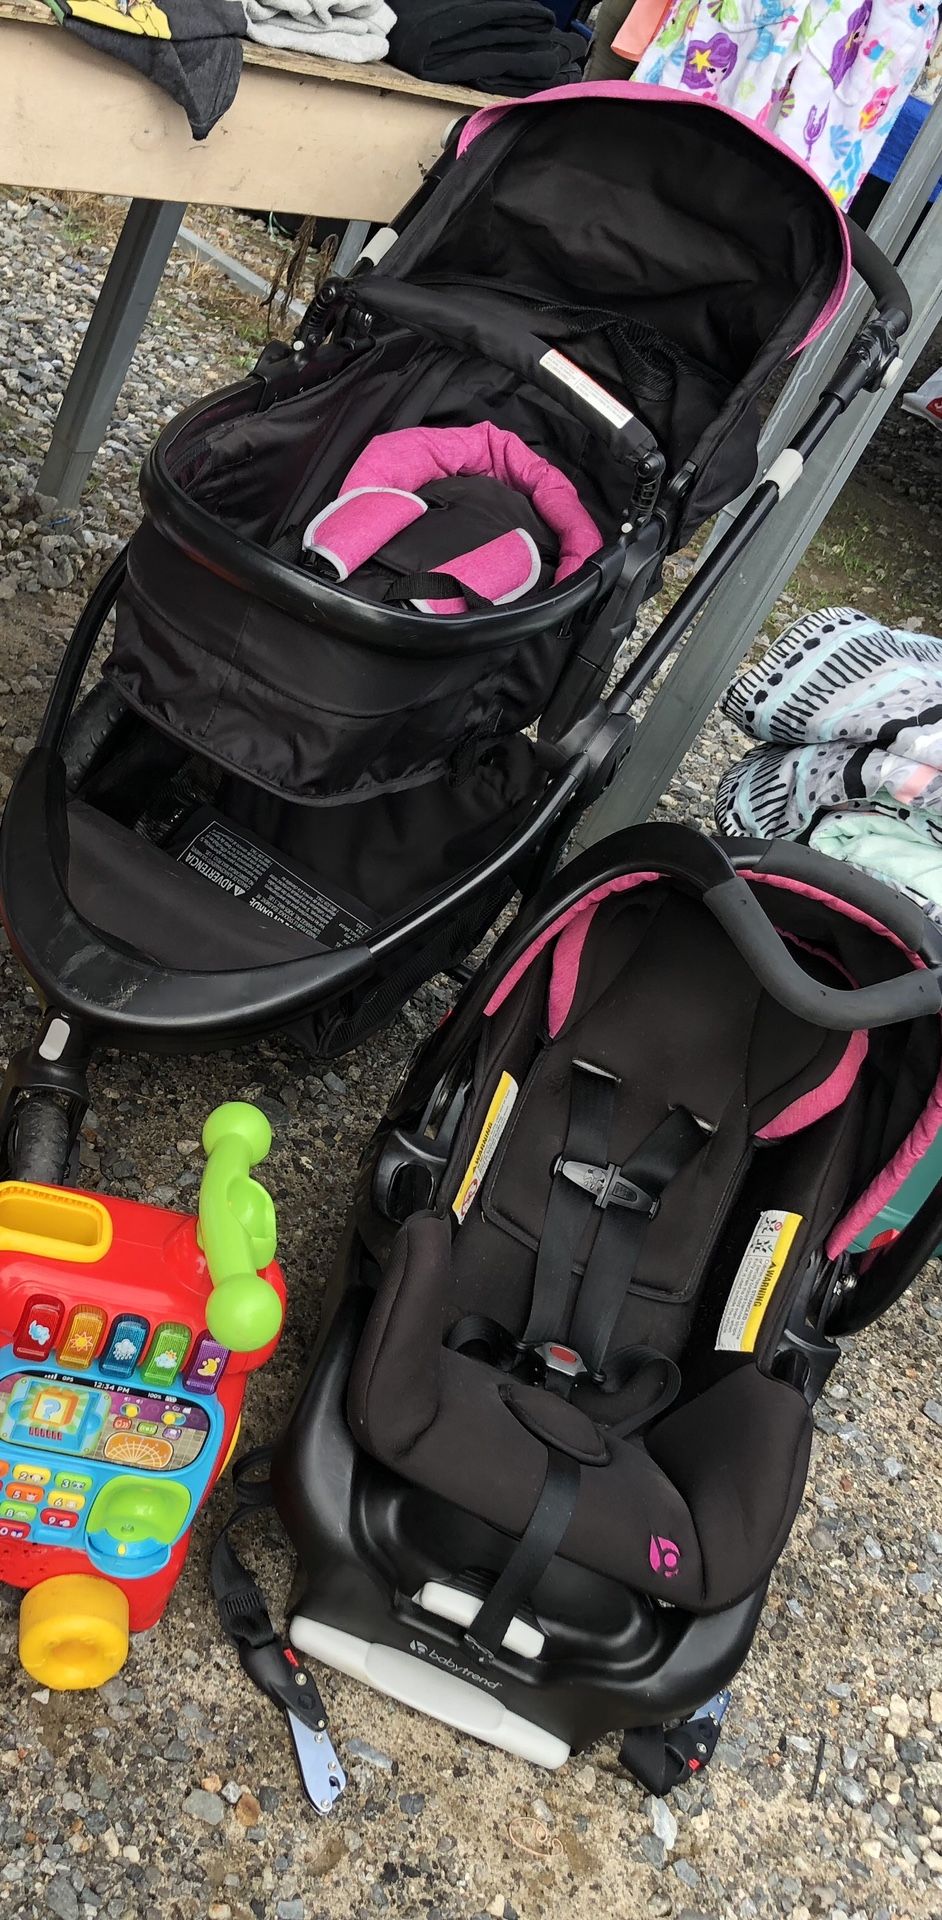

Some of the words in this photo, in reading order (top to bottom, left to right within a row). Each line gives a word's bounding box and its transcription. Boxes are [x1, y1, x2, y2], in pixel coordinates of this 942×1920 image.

[185, 852, 234, 890] ADVERTENCIA
[475, 1122, 492, 1164] WARNING
[753, 1270, 774, 1306] WARNING
[93, 1381, 115, 1391] 12:34
[117, 1386, 130, 1394] PM
[19, 1471, 28, 1481] 2
[61, 1479, 70, 1488] 3
[12, 1491, 21, 1499] 5
[54, 1498, 63, 1507] 6
[48, 1517, 56, 1525] 9
[428, 1649, 499, 1689] babytrend
